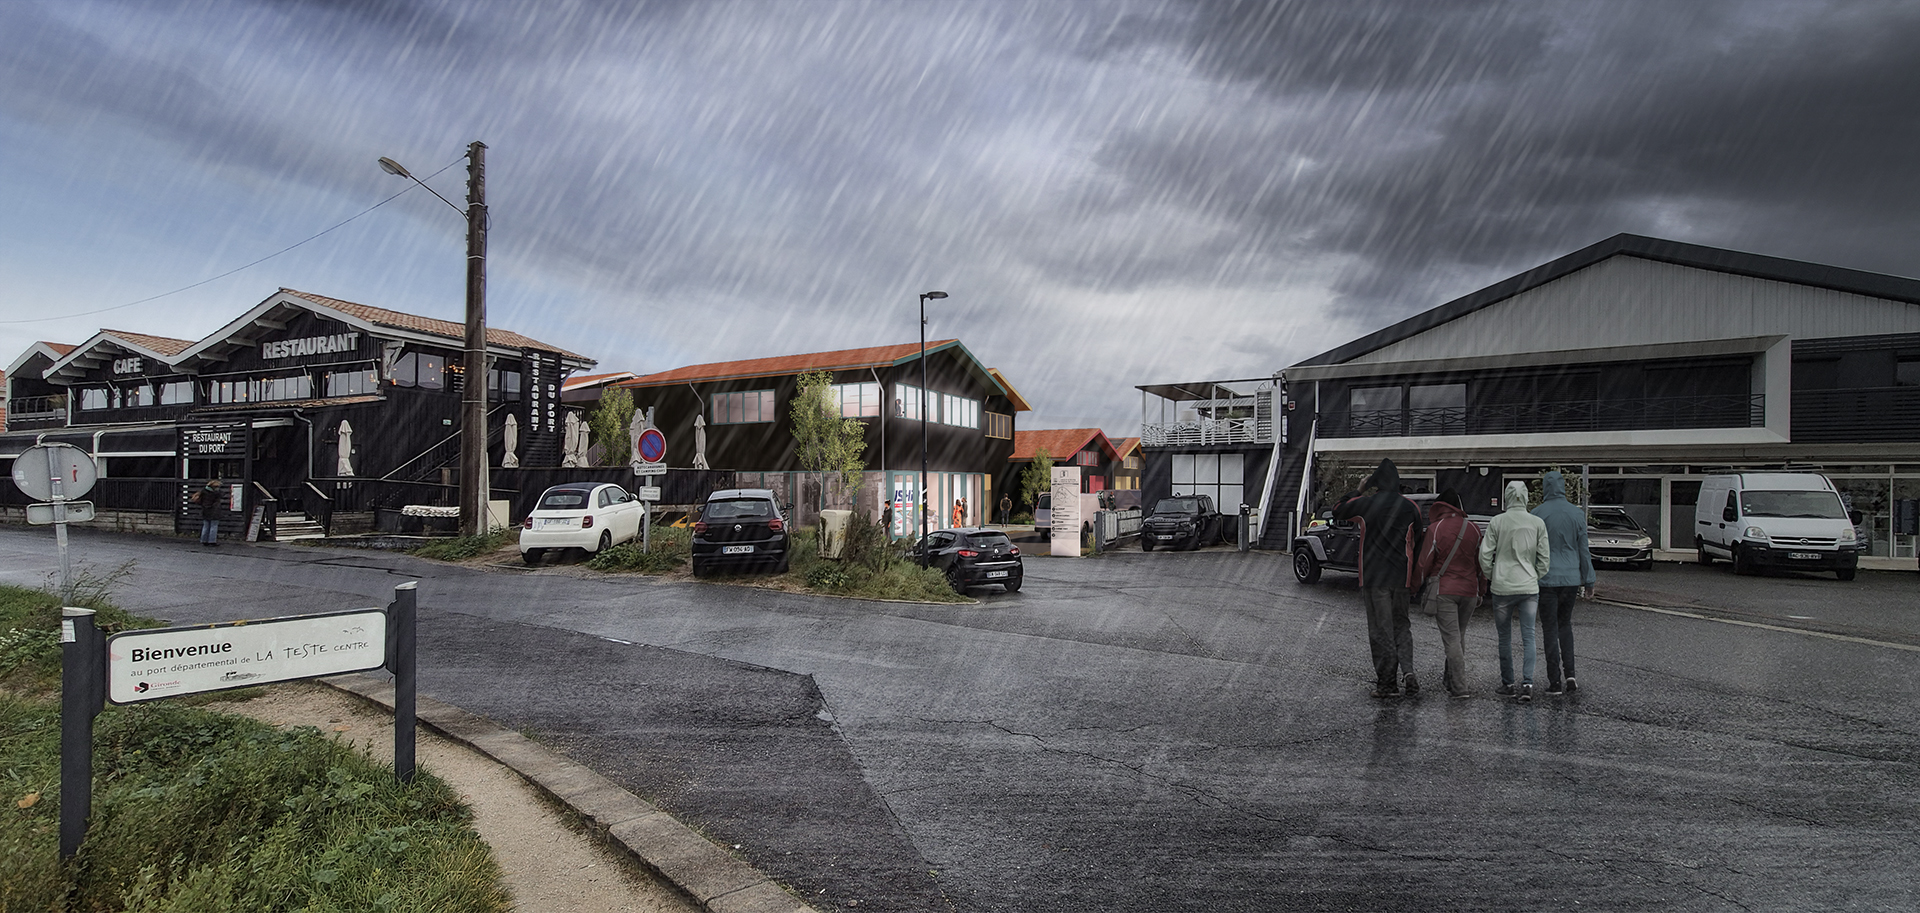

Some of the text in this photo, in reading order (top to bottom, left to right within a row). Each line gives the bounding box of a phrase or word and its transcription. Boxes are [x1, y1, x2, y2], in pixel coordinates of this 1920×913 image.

[263, 332, 358, 360] RESTAURANT
[113, 357, 142, 375] CAFE
[531, 353, 541, 431] RESTAURANT
[547, 384, 556, 433] DU PORT
[192, 433, 232, 443] RESTAURANT
[199, 444, 226, 453] DU PORT
[131, 642, 233, 663] Bienvenue
[147, 667, 167, 676] port
[170, 658, 238, 673] départemental
[240, 657, 251, 666] de
[256, 650, 274, 662] LA
[283, 643, 328, 659] TESTE
[333, 641, 369, 652] CENTRE
